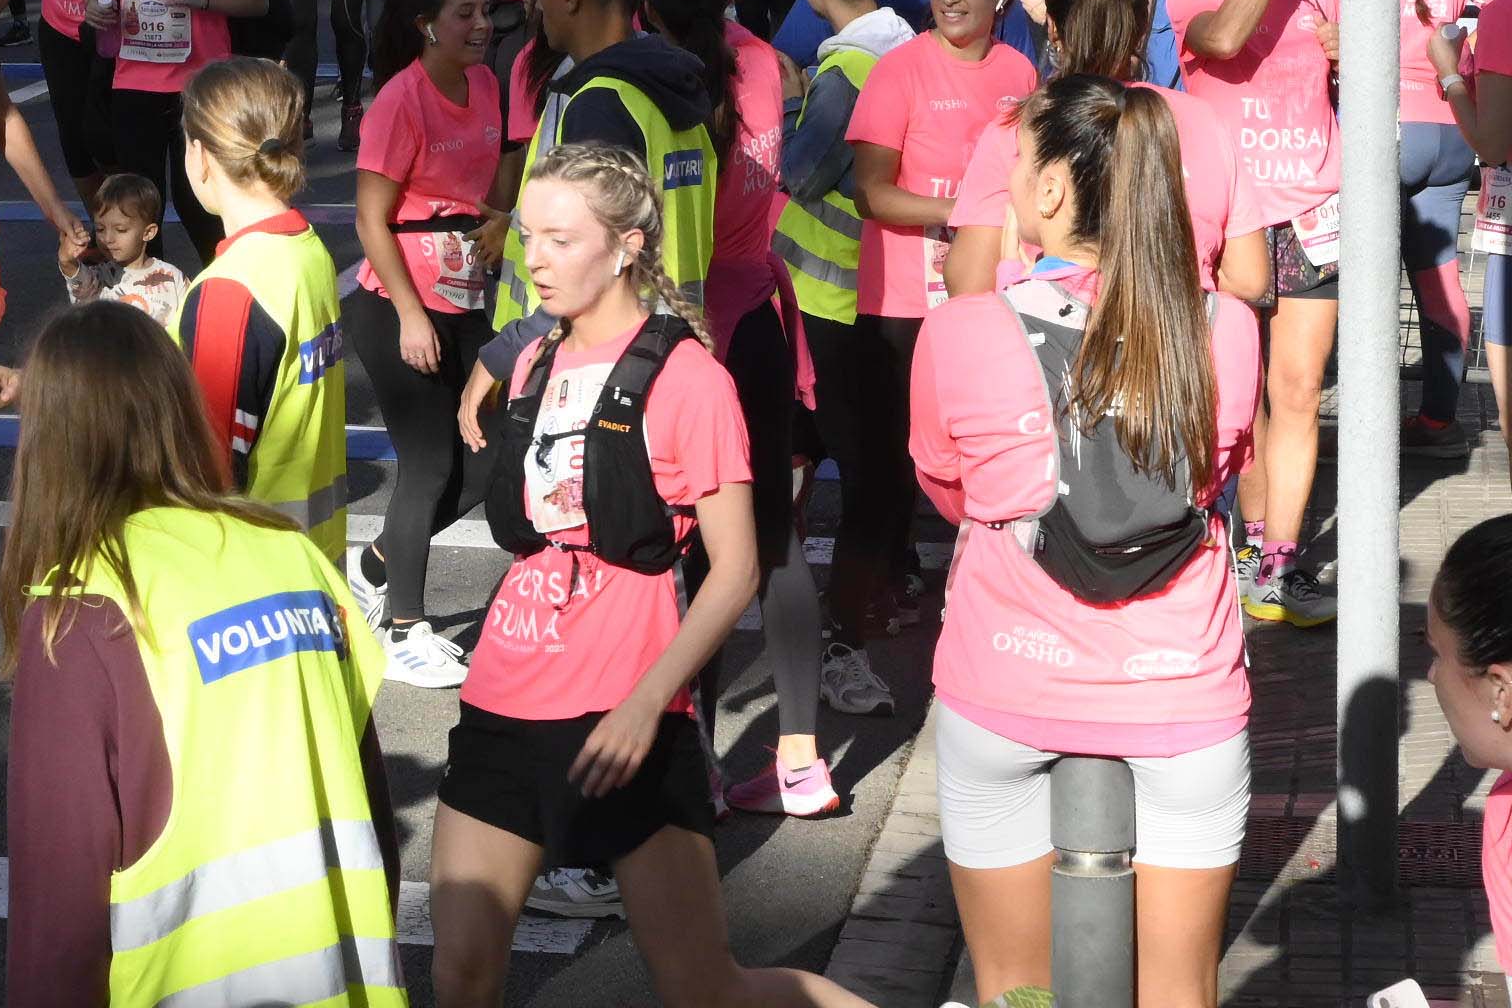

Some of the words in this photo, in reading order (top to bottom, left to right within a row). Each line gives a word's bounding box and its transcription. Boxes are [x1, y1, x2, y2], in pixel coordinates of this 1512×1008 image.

[141, 22, 165, 32] 016
[1242, 98, 1272, 120] TU
[1486, 195, 1506, 208] 16
[597, 419, 631, 433] EVADICT
[196, 606, 332, 664] VOLUNTA
[992, 632, 1075, 667] OYSHO
